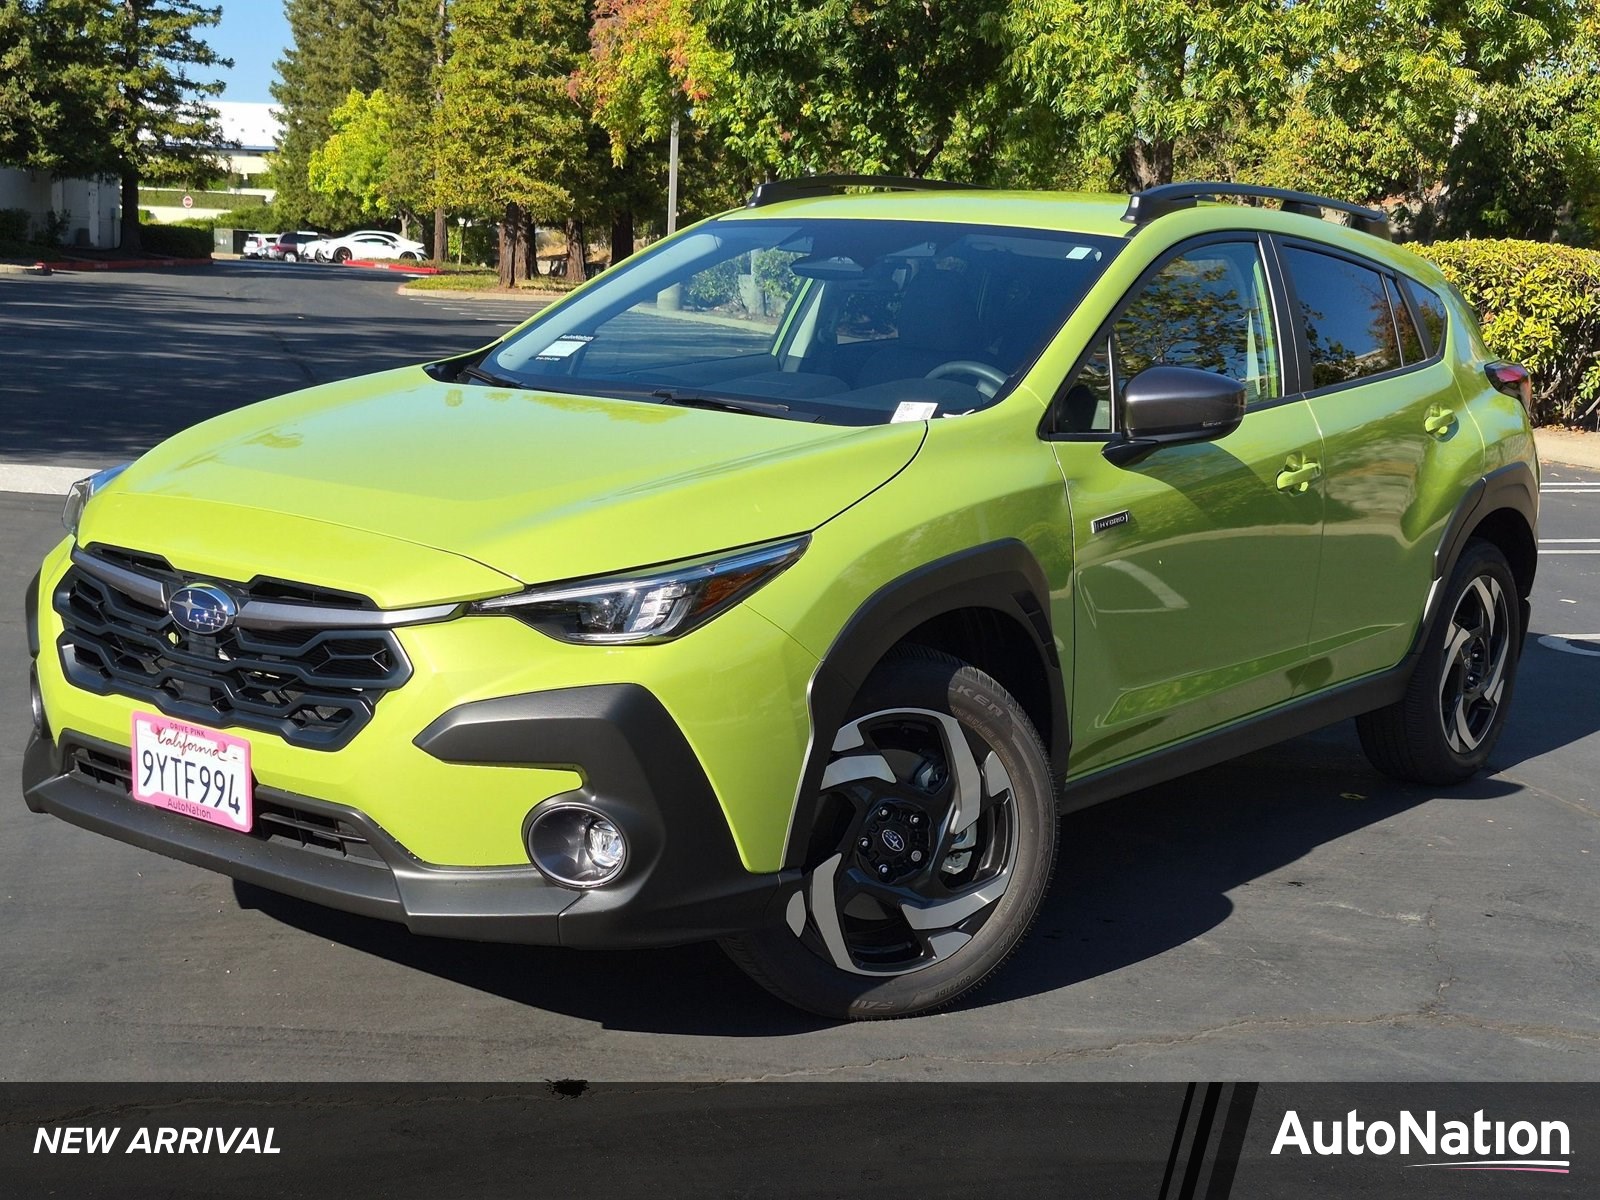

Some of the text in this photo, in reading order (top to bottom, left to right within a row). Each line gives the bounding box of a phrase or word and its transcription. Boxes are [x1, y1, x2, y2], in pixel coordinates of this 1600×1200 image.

[948, 685, 1004, 717] KEN
[157, 727, 228, 761] California
[169, 722, 206, 738] DRIVE PINK
[142, 749, 241, 815] 9YTF994
[167, 798, 212, 819] AutoNation
